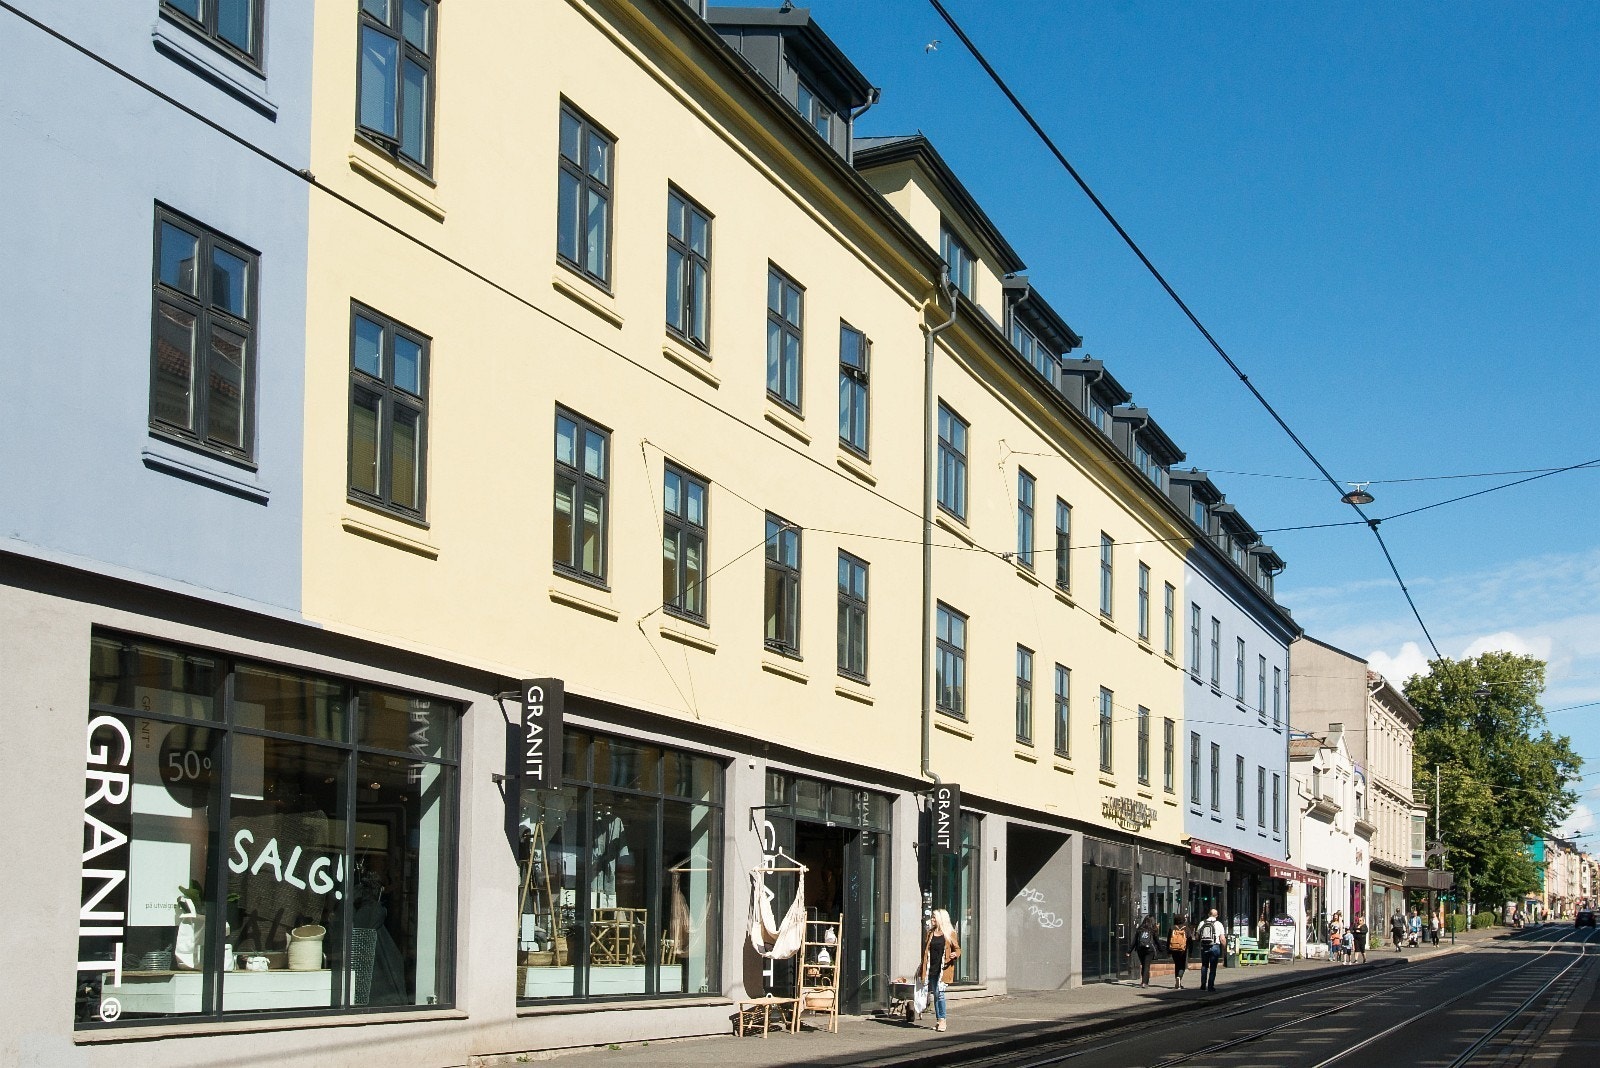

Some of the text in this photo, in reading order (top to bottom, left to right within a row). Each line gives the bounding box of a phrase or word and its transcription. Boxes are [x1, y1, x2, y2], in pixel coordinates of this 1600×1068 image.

[525, 685, 544, 781] GRANIT
[938, 787, 951, 849] GRANIT
[228, 828, 344, 900] SALG!
